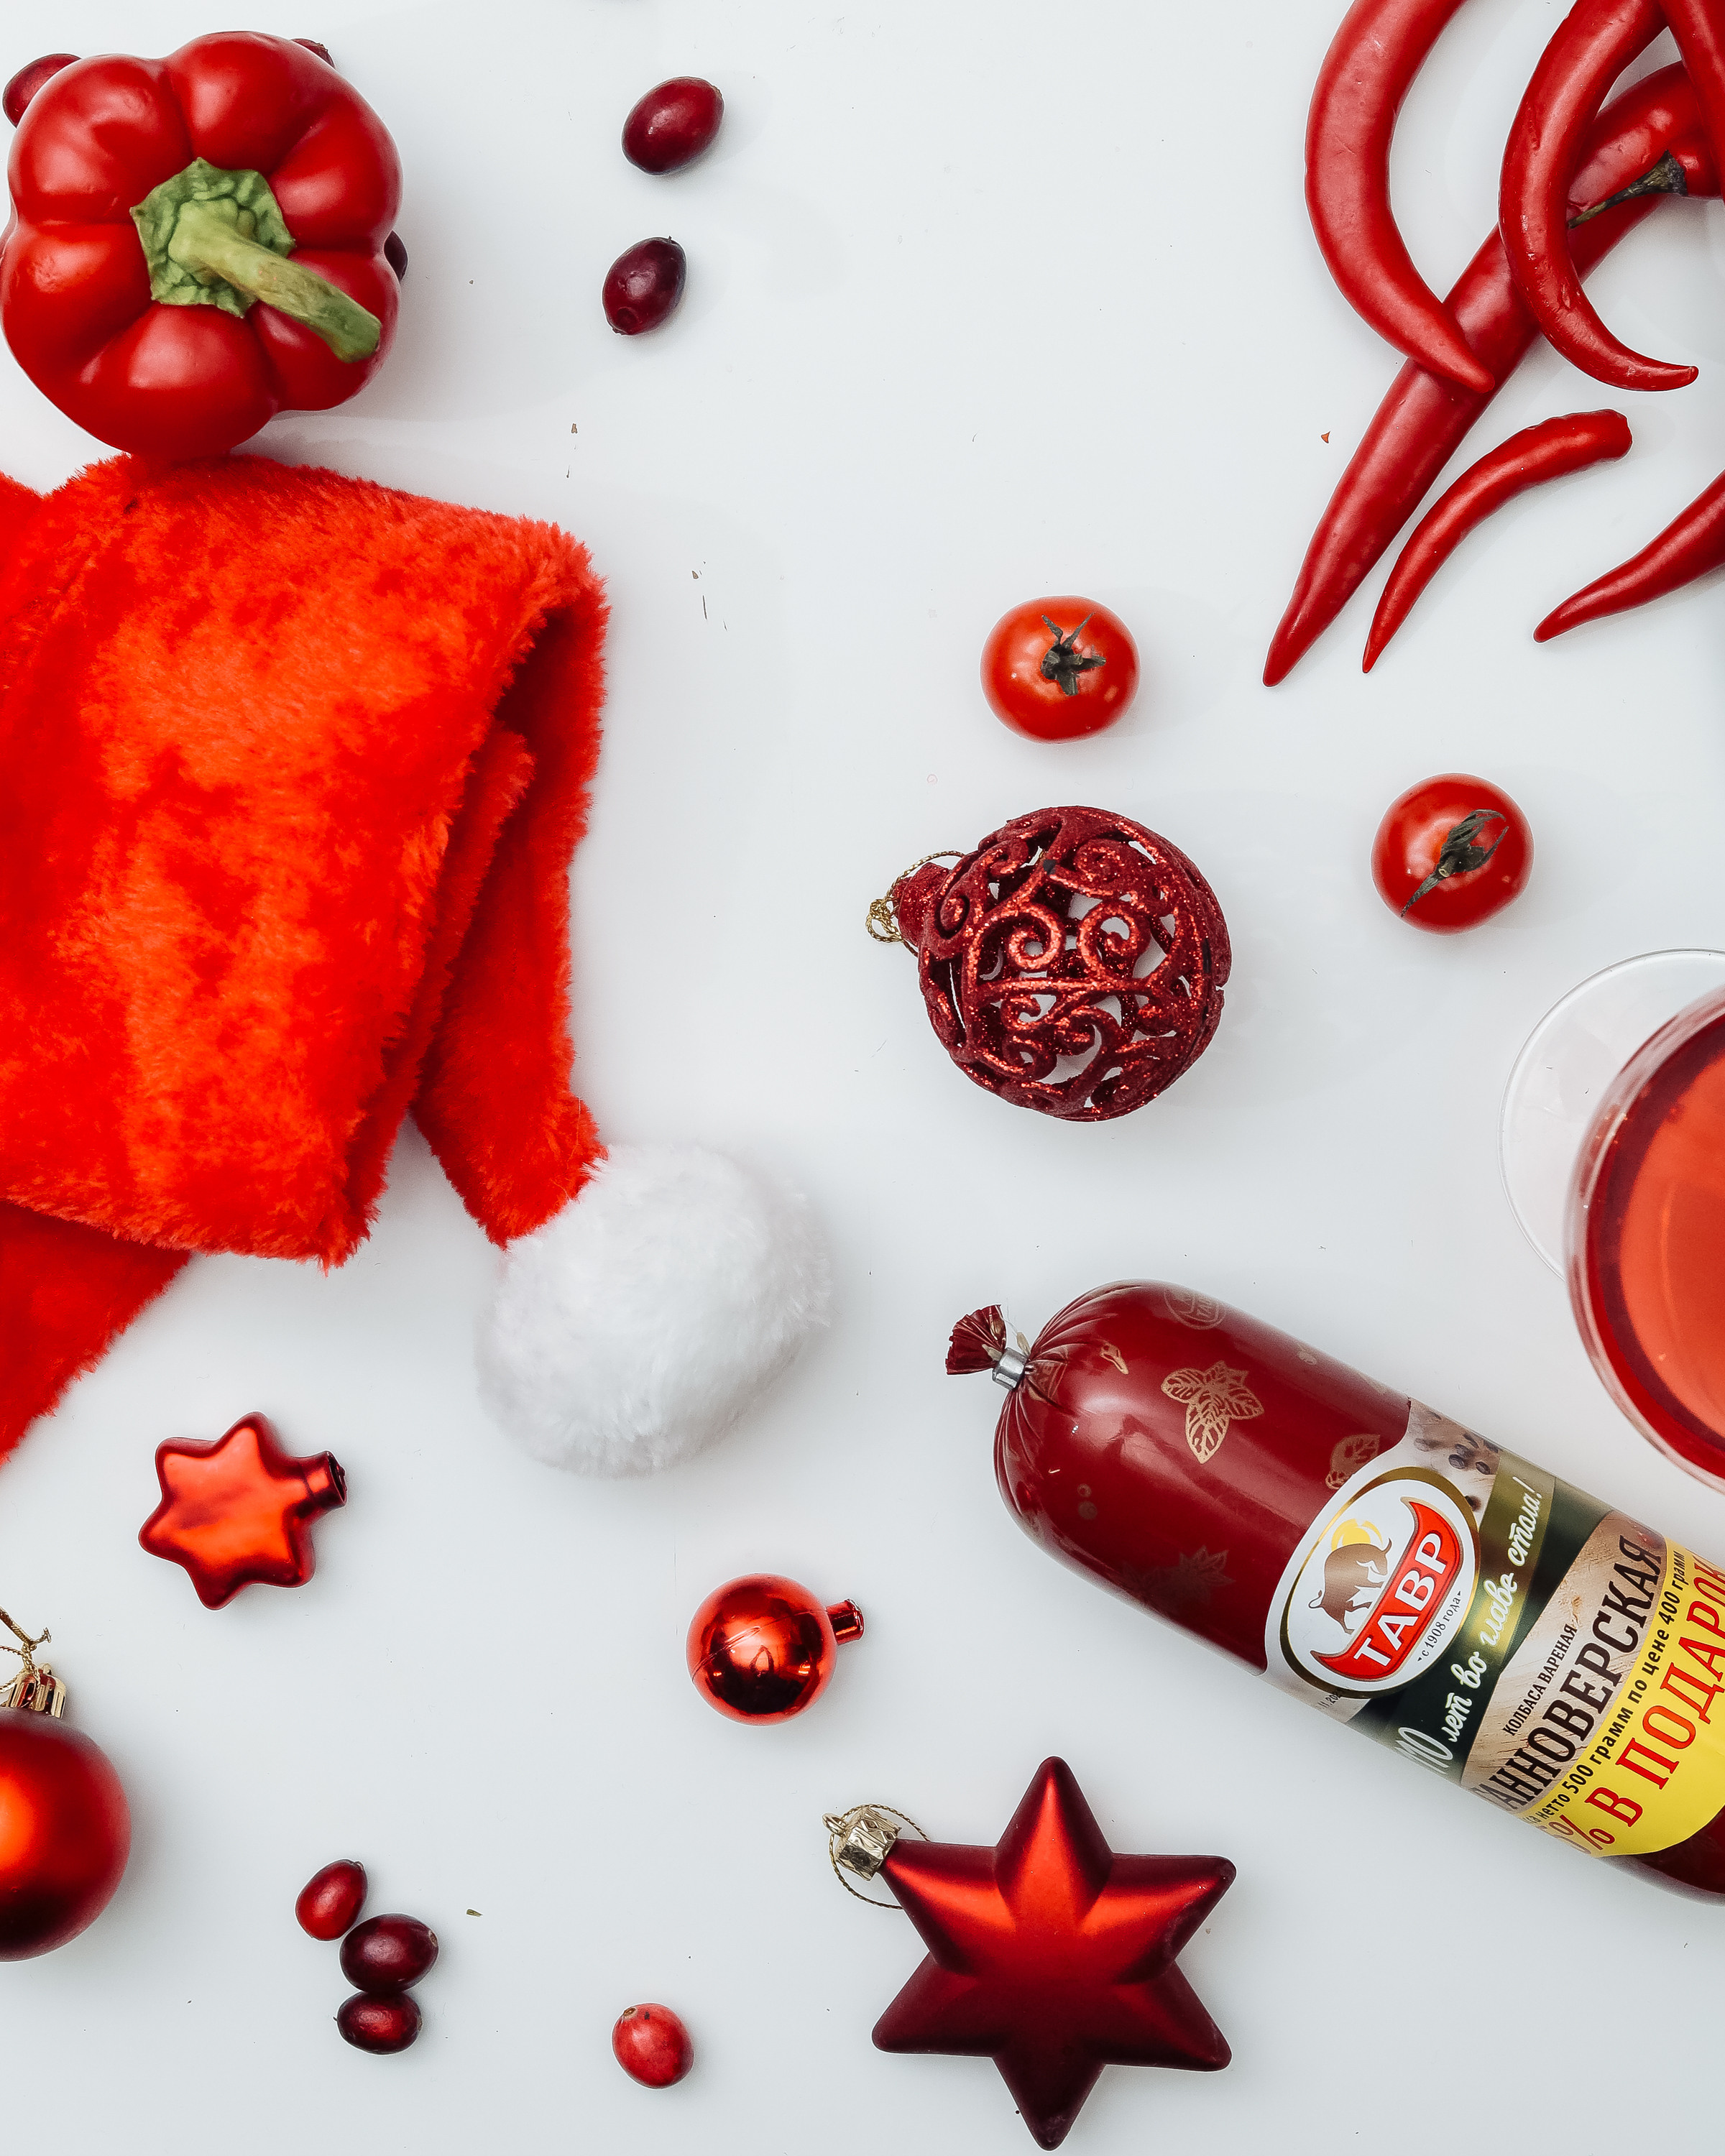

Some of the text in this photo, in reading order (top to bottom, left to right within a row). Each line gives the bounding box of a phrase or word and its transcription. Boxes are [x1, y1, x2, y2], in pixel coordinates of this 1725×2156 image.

[1508, 1475, 1542, 1567] стола!
[1353, 1531, 1447, 1667] ТАВР
[1424, 1622, 1446, 1649] 1908
[1444, 1597, 1461, 1622] года
[1479, 1572, 1518, 1646] главе
[1450, 1651, 1488, 1689] во
[1502, 1623, 1578, 1736] КОЛБАСА ВАРЕНАЯ
[1535, 1793, 1570, 1820] нетто
[1562, 1764, 1593, 1794] 500
[1589, 1705, 1634, 1765] грамм
[1627, 1680, 1647, 1704] по
[1642, 1628, 1670, 1676] цене
[1658, 1591, 1680, 1625] 400
[1672, 1550, 1689, 1590] грамм
[1441, 1692, 1473, 1743] лет
[1584, 1787, 1643, 1828] В
